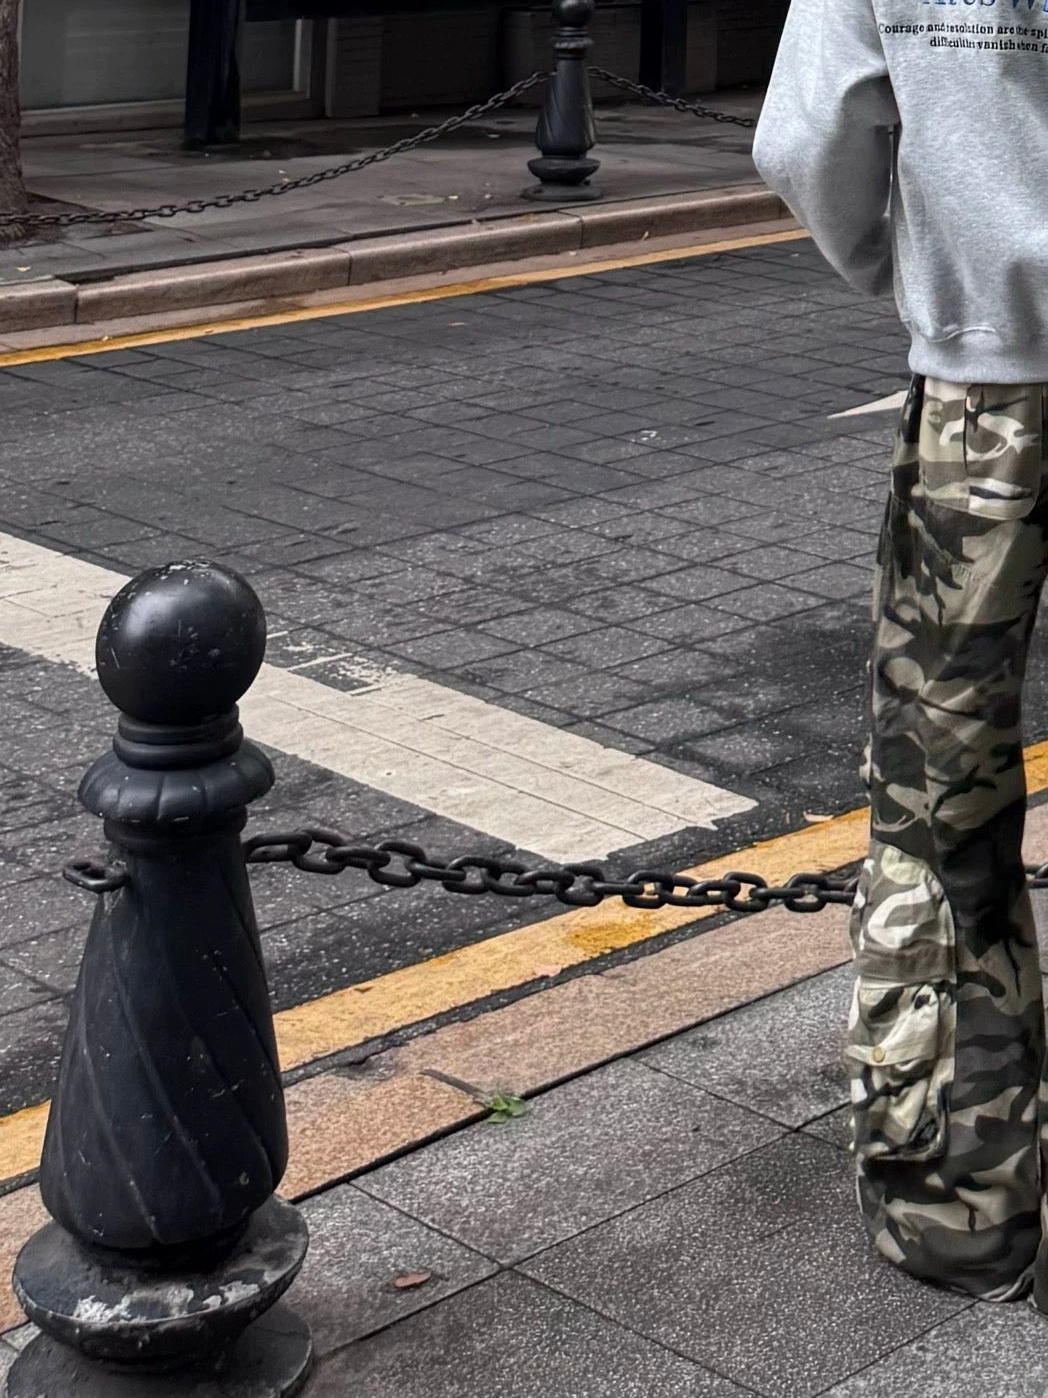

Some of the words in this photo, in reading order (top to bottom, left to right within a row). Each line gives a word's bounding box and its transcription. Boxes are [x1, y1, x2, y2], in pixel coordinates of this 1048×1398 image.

[878, 22, 925, 35] Courage
[926, 22, 945, 32] and
[997, 26, 1015, 35] are
[976, 39, 1016, 51] vanish
